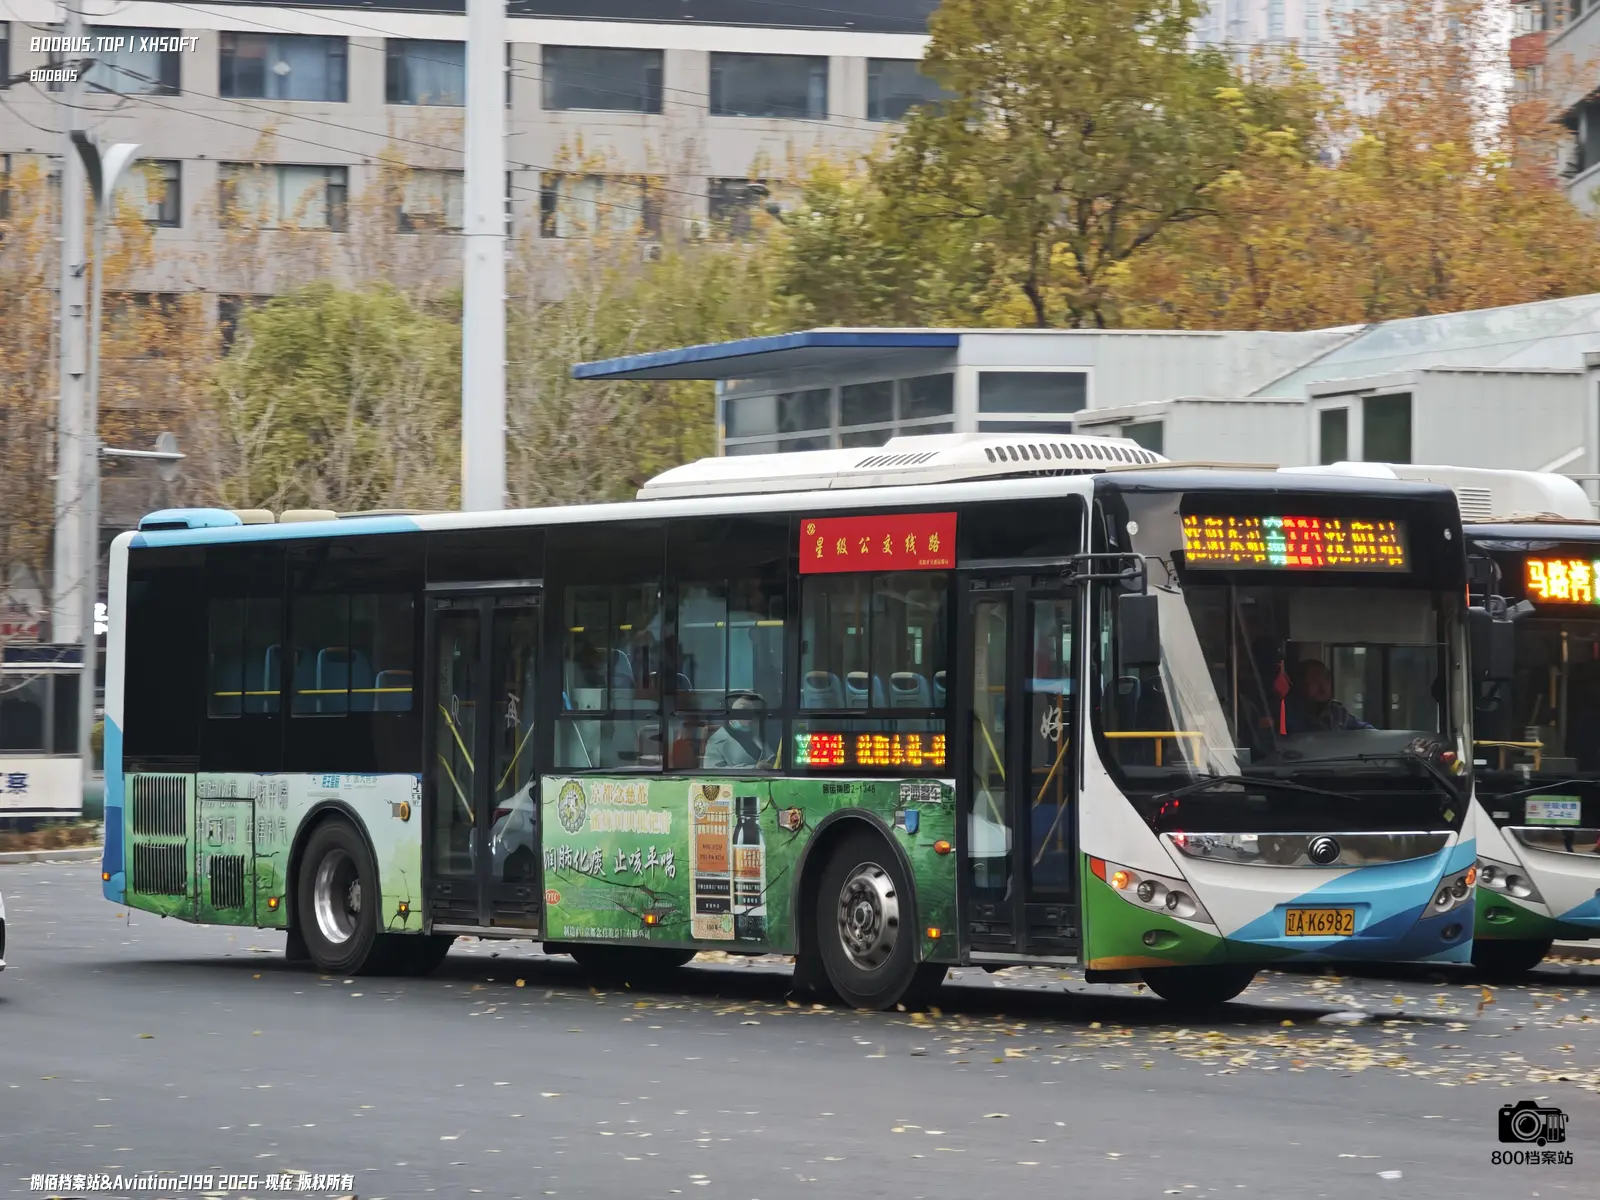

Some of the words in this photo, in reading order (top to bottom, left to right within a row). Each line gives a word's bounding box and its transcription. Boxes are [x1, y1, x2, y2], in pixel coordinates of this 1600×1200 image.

[815, 532, 941, 559] 星级公交线路
[543, 844, 606, 877] 润肺化痰
[614, 844, 677, 880] 止咳平喘
[545, 892, 559, 902] OTC
